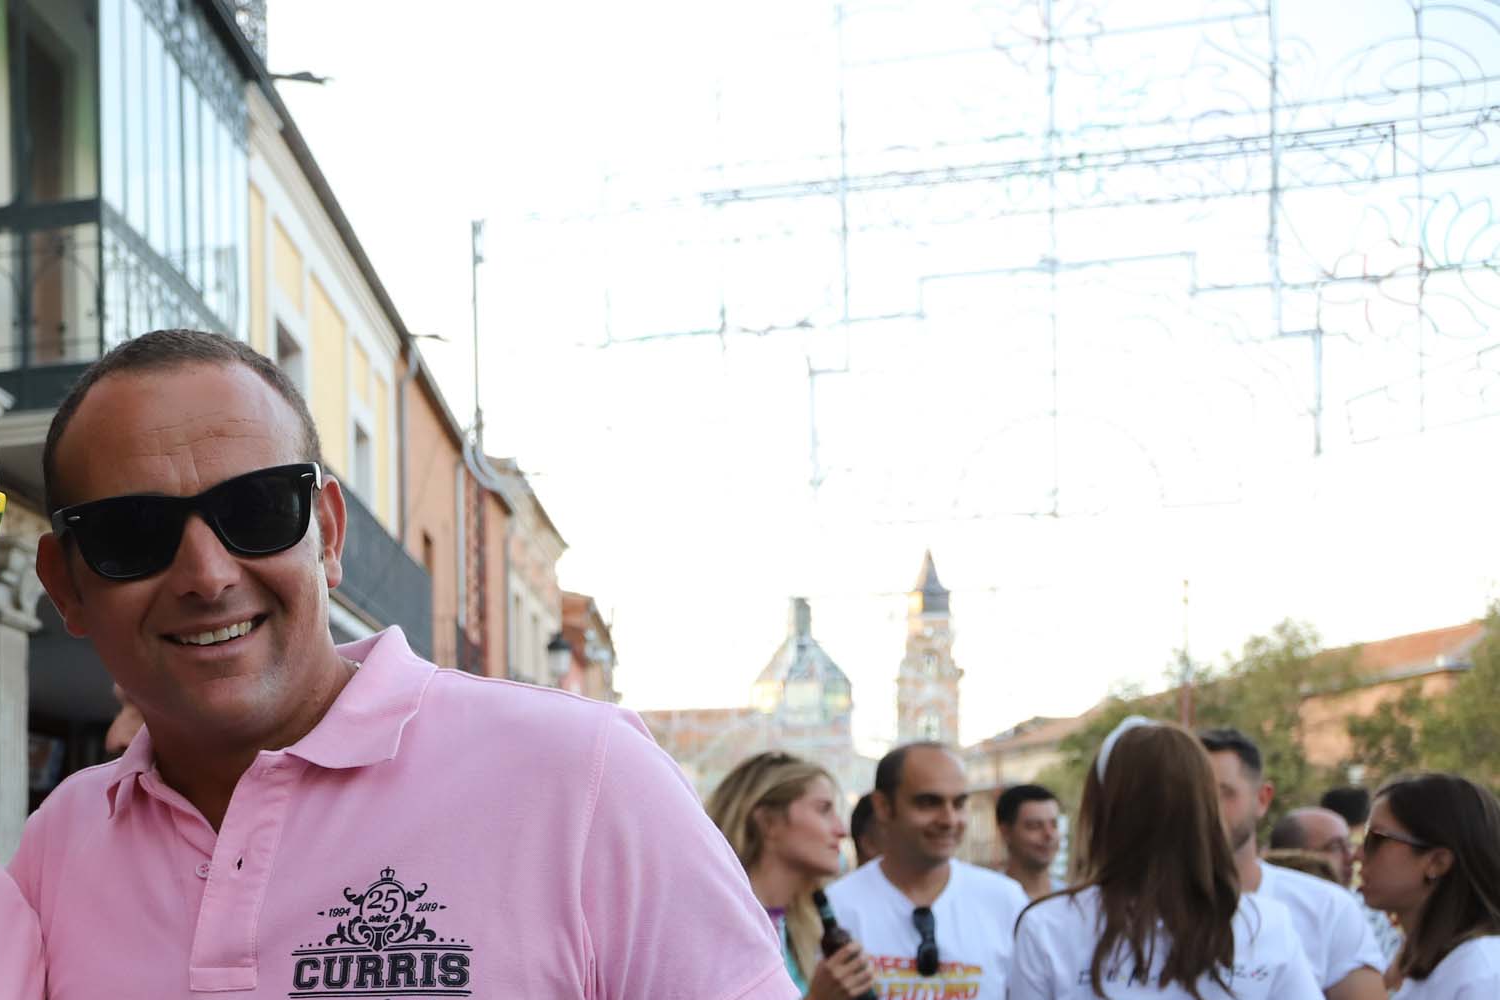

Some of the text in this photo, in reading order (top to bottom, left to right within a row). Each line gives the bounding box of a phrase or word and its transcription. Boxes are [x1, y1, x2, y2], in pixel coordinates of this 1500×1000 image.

[367, 889, 399, 913] 25
[415, 902, 438, 912] 2019
[328, 907, 351, 917] 1994
[293, 953, 470, 990] CURRIS
